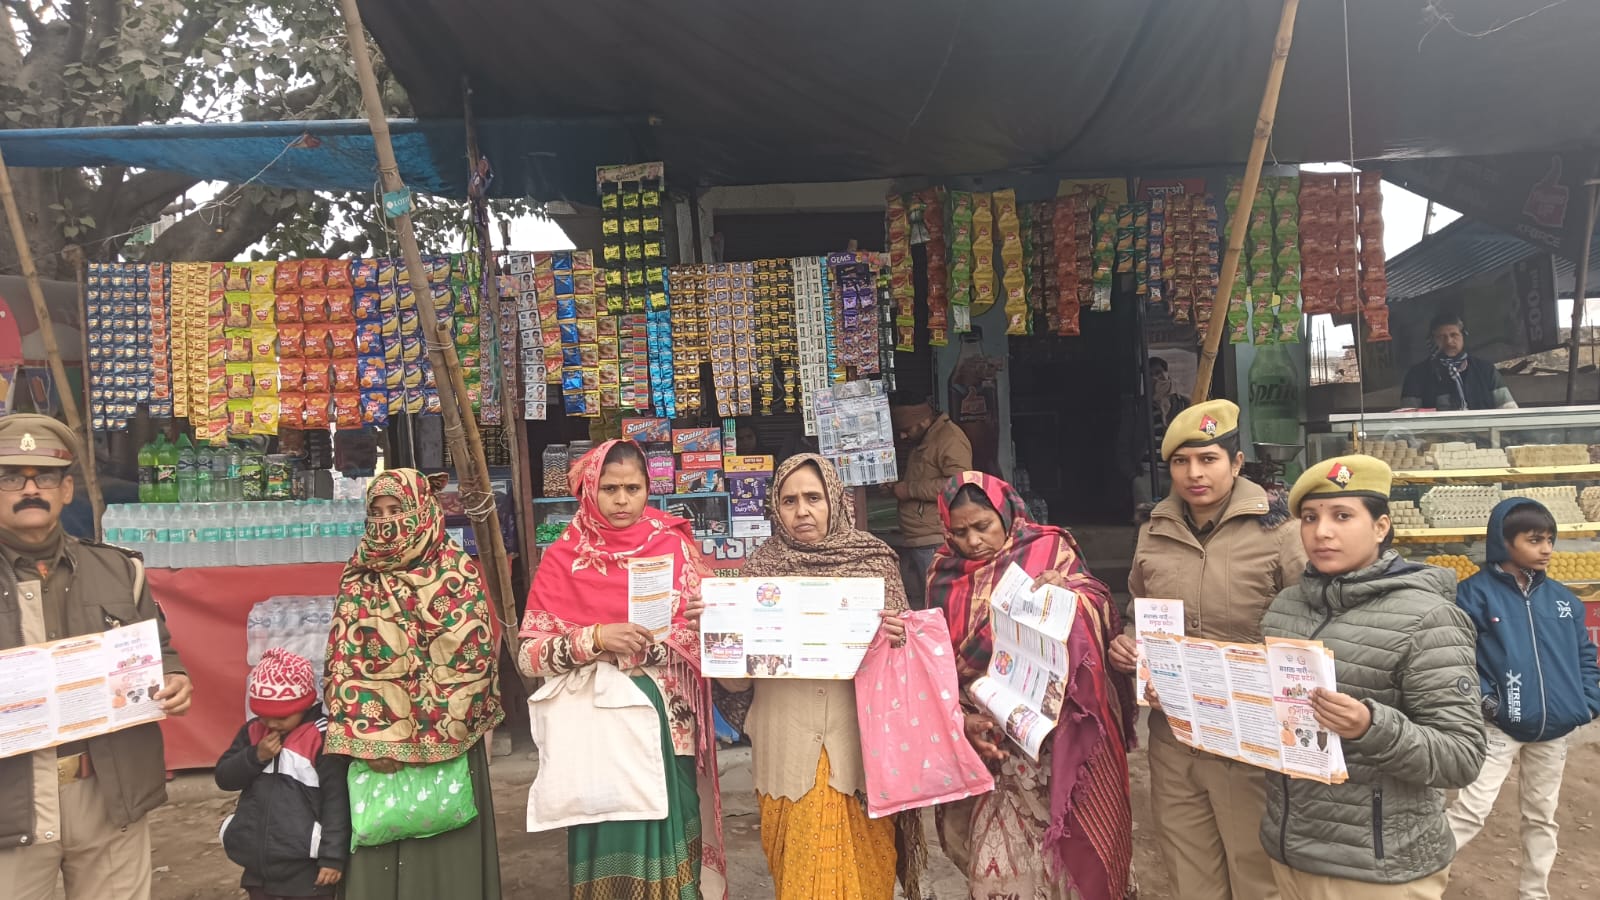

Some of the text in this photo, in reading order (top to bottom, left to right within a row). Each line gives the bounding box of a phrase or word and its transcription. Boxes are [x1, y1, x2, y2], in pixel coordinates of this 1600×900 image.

[830, 254, 851, 264] GEMS
[1249, 377, 1296, 407] Sprite
[1506, 669, 1522, 722] XTREME
